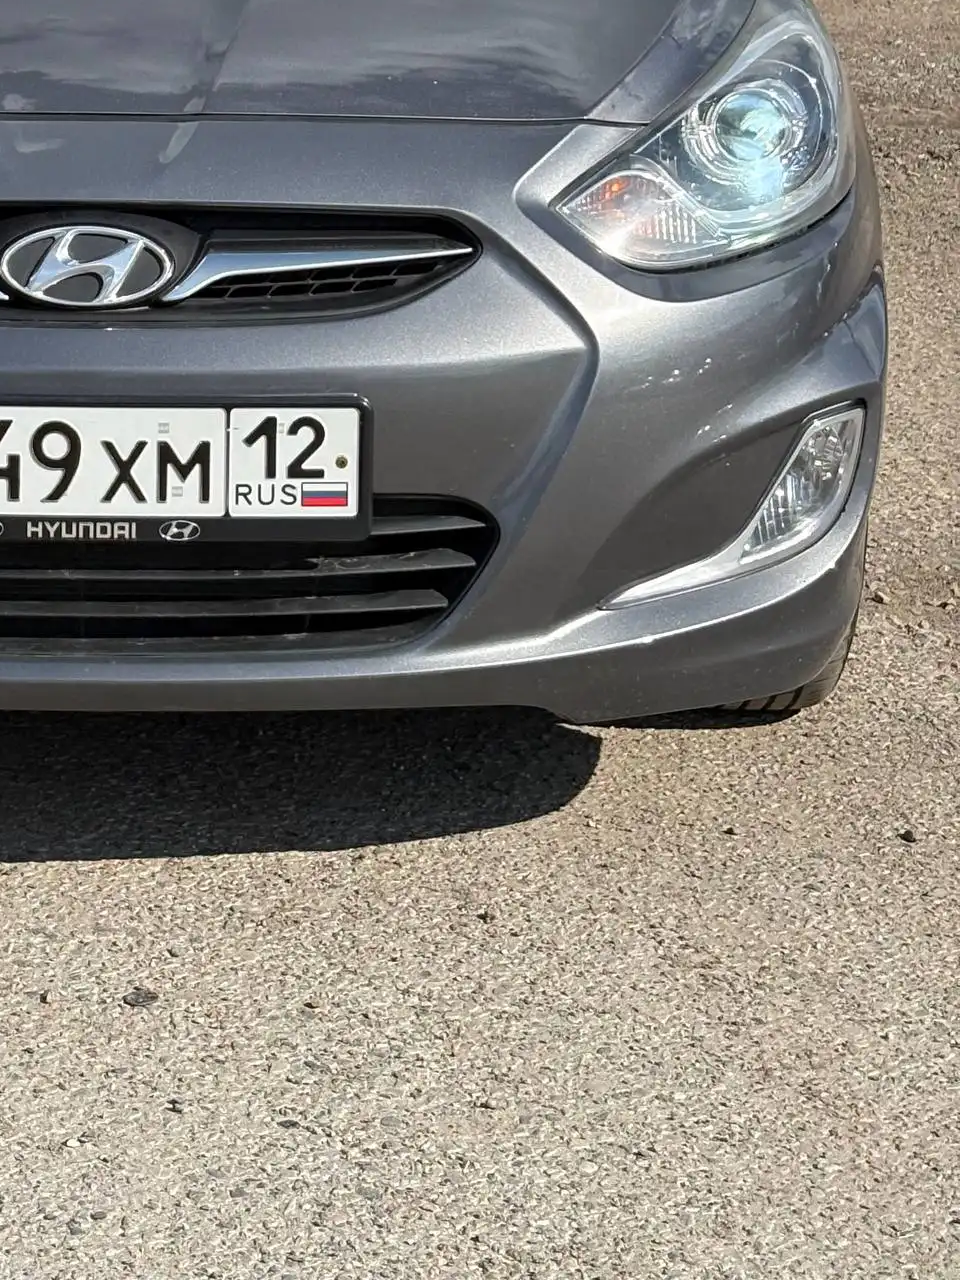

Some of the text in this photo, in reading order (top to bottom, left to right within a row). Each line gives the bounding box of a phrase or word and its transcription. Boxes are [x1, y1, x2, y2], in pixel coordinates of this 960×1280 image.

[242, 415, 327, 480] 12
[235, 483, 298, 506] RUS
[26, 521, 138, 540] HYUNDAI
